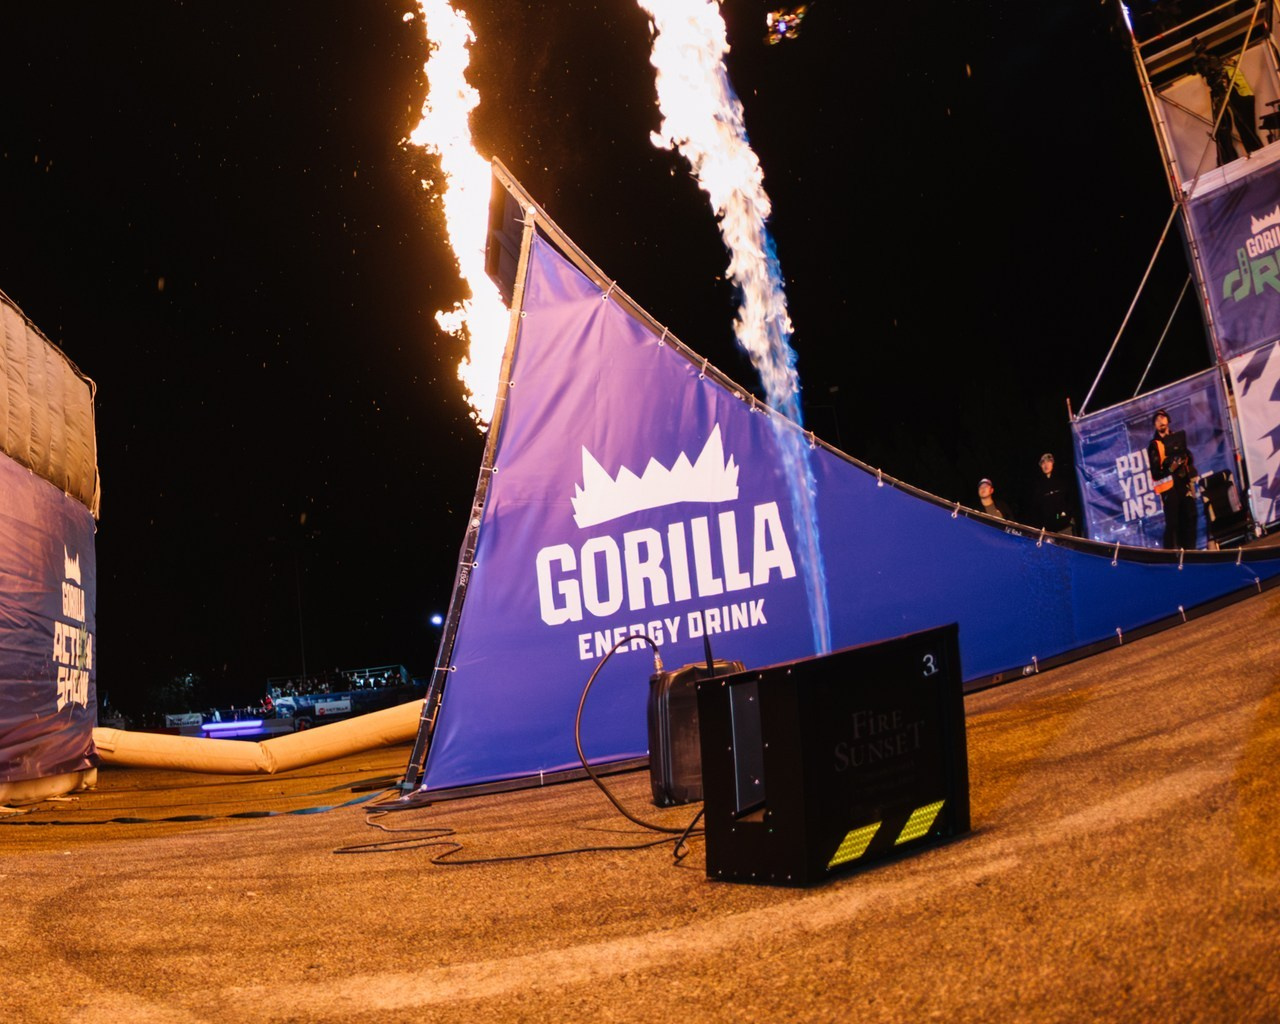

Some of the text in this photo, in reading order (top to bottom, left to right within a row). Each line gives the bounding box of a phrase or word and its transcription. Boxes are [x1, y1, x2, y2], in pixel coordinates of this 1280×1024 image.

[536, 501, 796, 626] GORILLA
[578, 598, 767, 660] ENERGY DRINK
[56, 666, 89, 712] SHOW
[922, 653, 939, 677] 3
